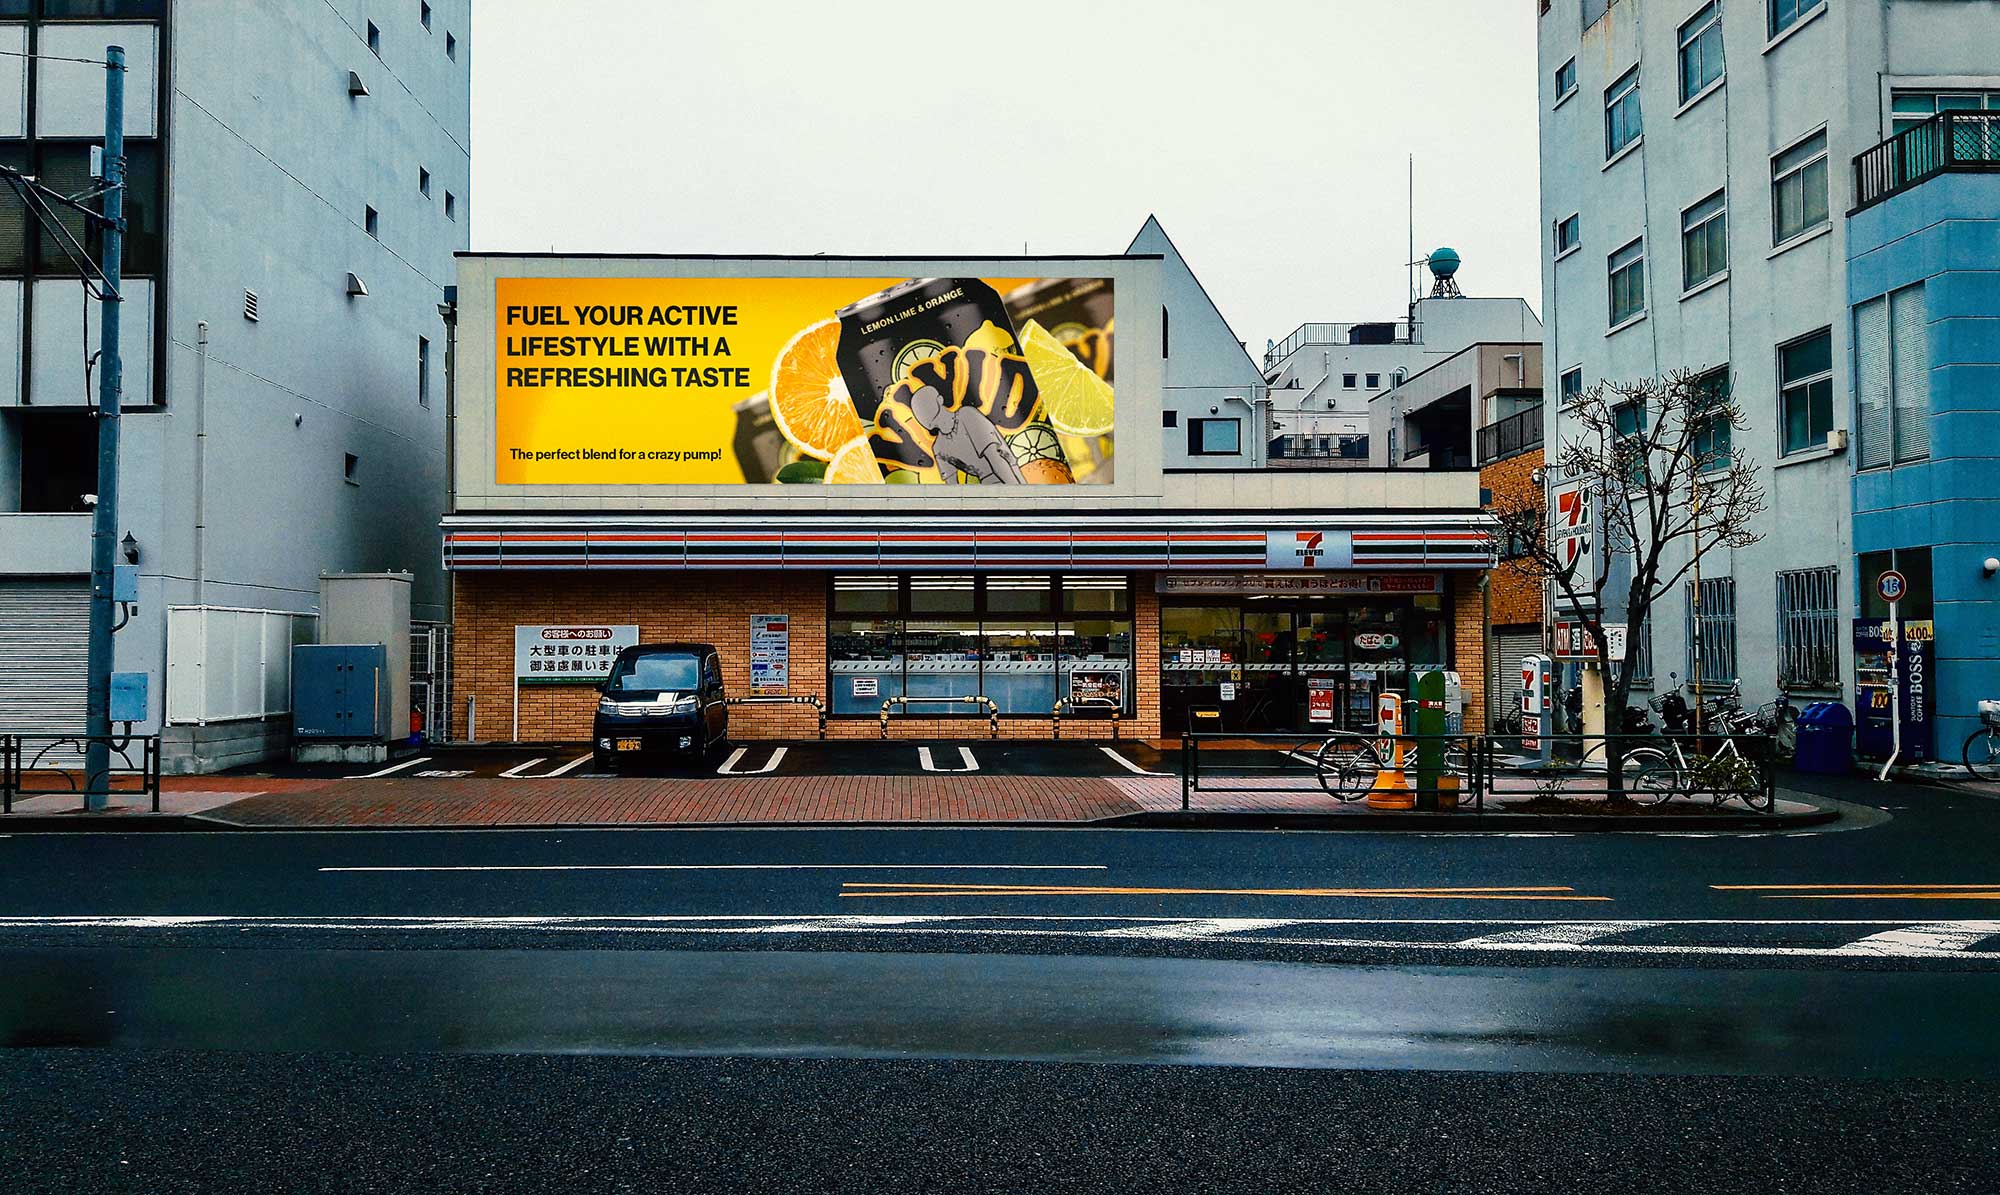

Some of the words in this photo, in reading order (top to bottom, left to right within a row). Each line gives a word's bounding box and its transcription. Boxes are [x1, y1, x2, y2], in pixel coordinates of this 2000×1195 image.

[506, 305, 569, 326] FUEL
[574, 305, 643, 326] YOUR
[648, 305, 738, 326] ACTIVE
[860, 317, 894, 335] LEMON
[894, 308, 917, 323] LIME
[917, 304, 925, 313] &
[925, 287, 964, 309] ORANGE
[506, 336, 639, 356] LIFESTYLE
[644, 336, 709, 356] WITH
[713, 336, 731, 356] A
[506, 367, 667, 387] REFRESHING
[671, 367, 750, 387] TASTE
[509, 448, 534, 460] The
[536, 448, 580, 462] perfect
[582, 448, 617, 460] blend
[619, 448, 636, 460] for
[638, 450, 646, 460] a
[648, 450, 681, 462] crazy
[683, 448, 722, 462] pump!
[543, 629, 611, 639] お客様へのお願い
[1557, 628, 1569, 651] ATM
[529, 644, 624, 657] 大型車の駐車は
[529, 660, 616, 672] 御遠慮願いま
[1909, 654, 1923, 694] BOSS
